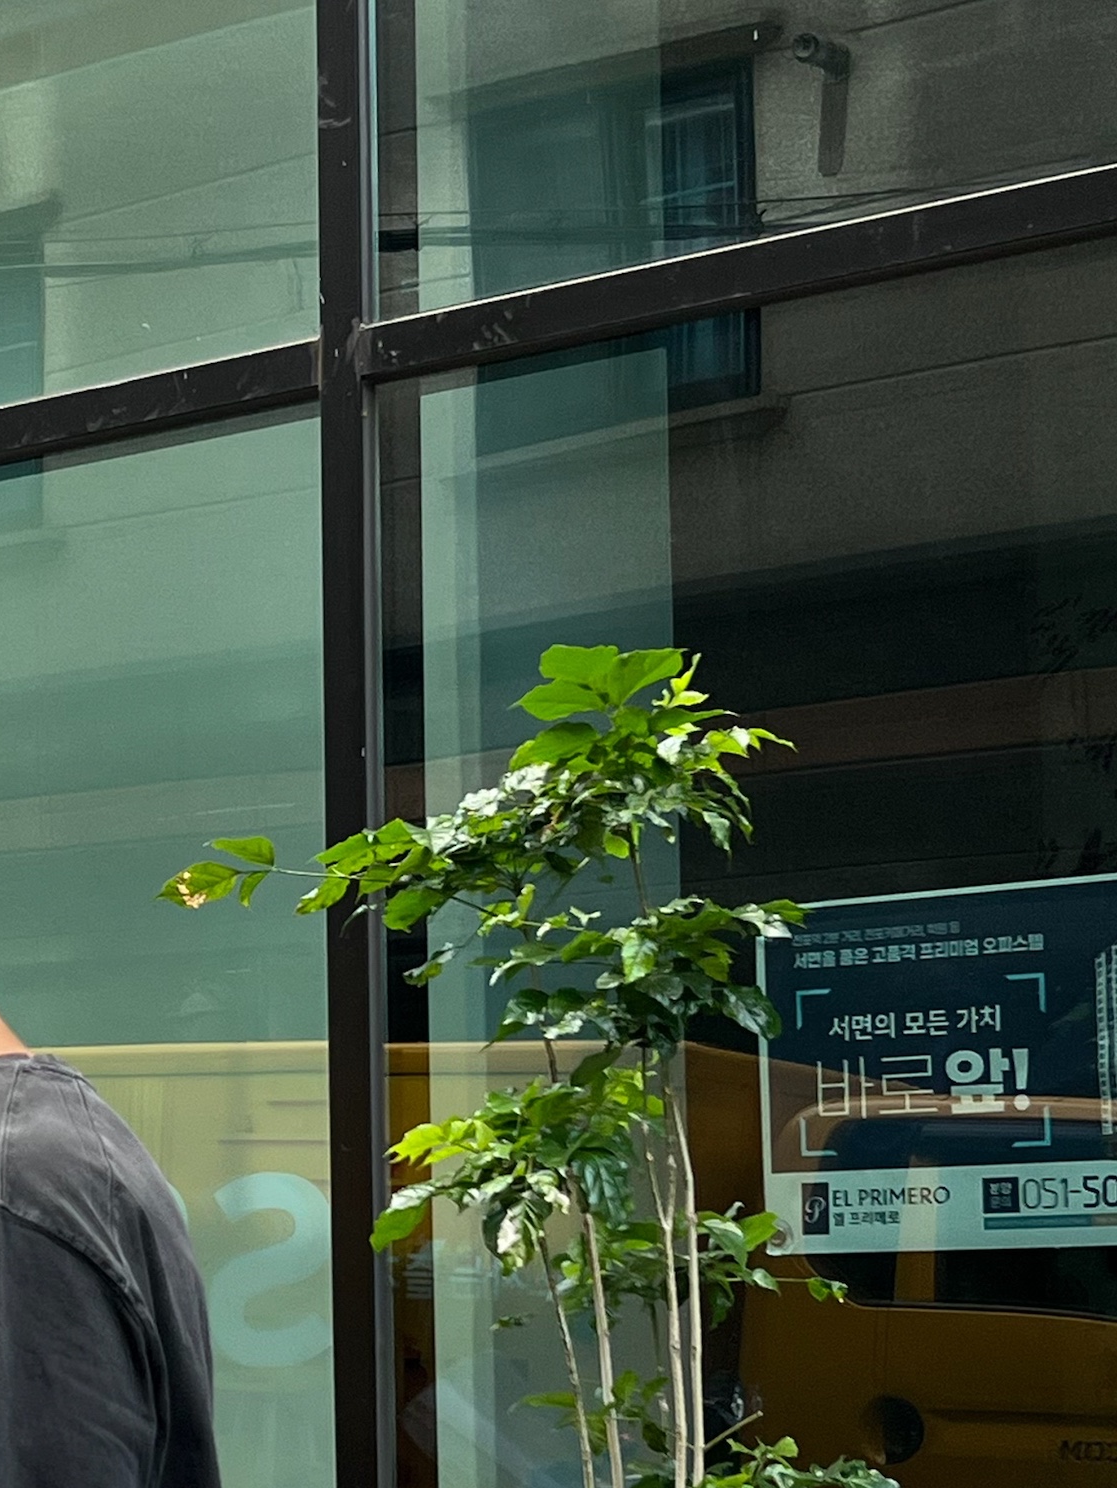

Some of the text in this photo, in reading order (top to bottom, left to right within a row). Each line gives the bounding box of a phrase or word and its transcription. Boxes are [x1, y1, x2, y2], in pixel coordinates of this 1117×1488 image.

[918, 938, 979, 960] 프리미엄
[982, 932, 1045, 954] 오피스텔
[828, 1004, 1002, 1042] 서면의 모든 가치
[832, 1186, 951, 1208] EL PRIMERO
